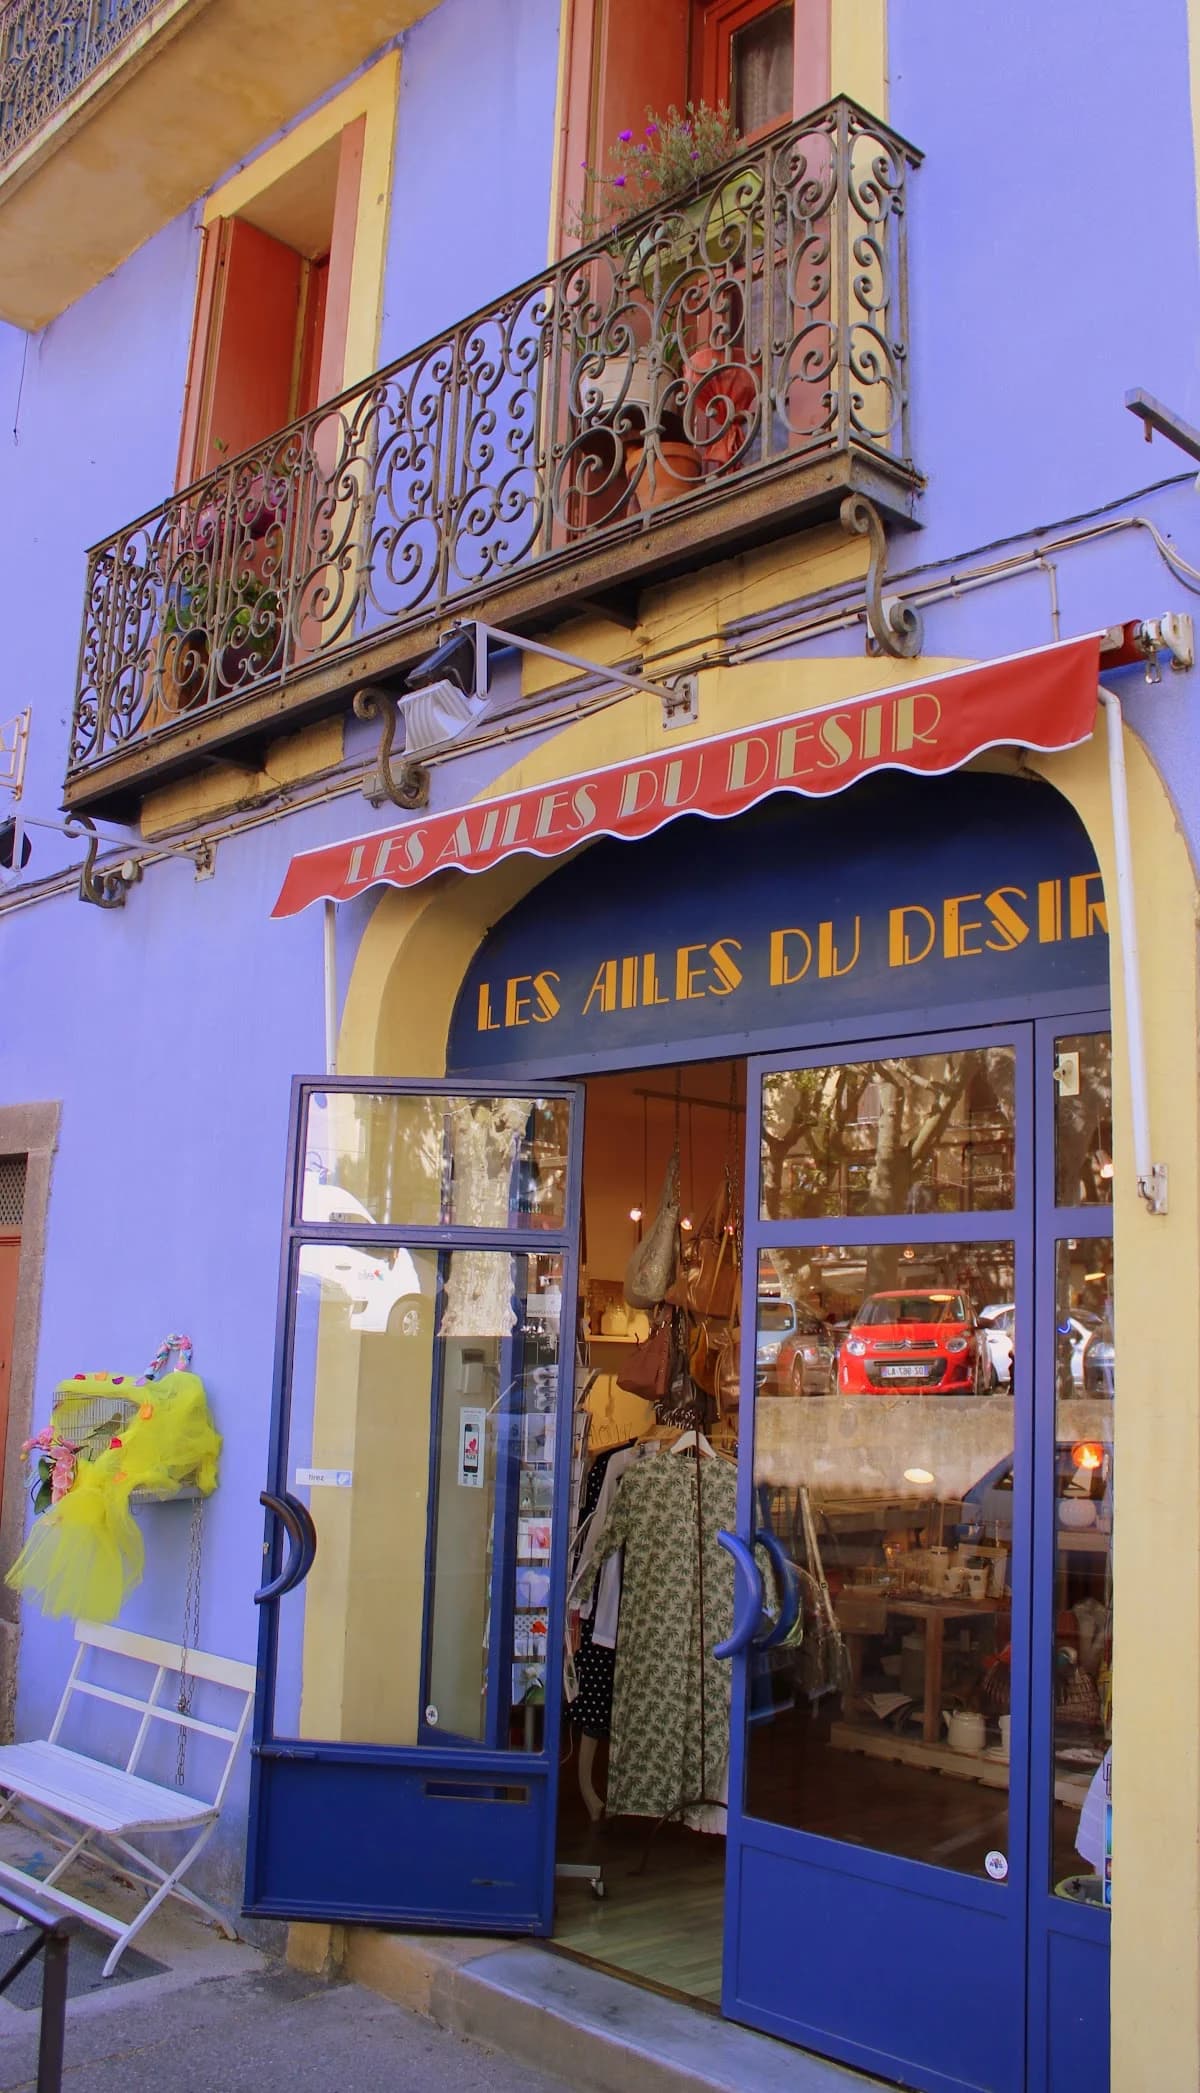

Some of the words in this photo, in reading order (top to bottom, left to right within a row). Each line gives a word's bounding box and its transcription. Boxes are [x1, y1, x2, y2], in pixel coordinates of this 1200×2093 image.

[344, 829, 428, 885] LES
[436, 783, 598, 863] AILES
[617, 753, 703, 819] DU
[725, 693, 941, 792] DESIR
[477, 970, 561, 1031] LES
[581, 938, 743, 1016] AILES
[769, 915, 860, 986] DU
[889, 872, 1109, 968] DESIR
